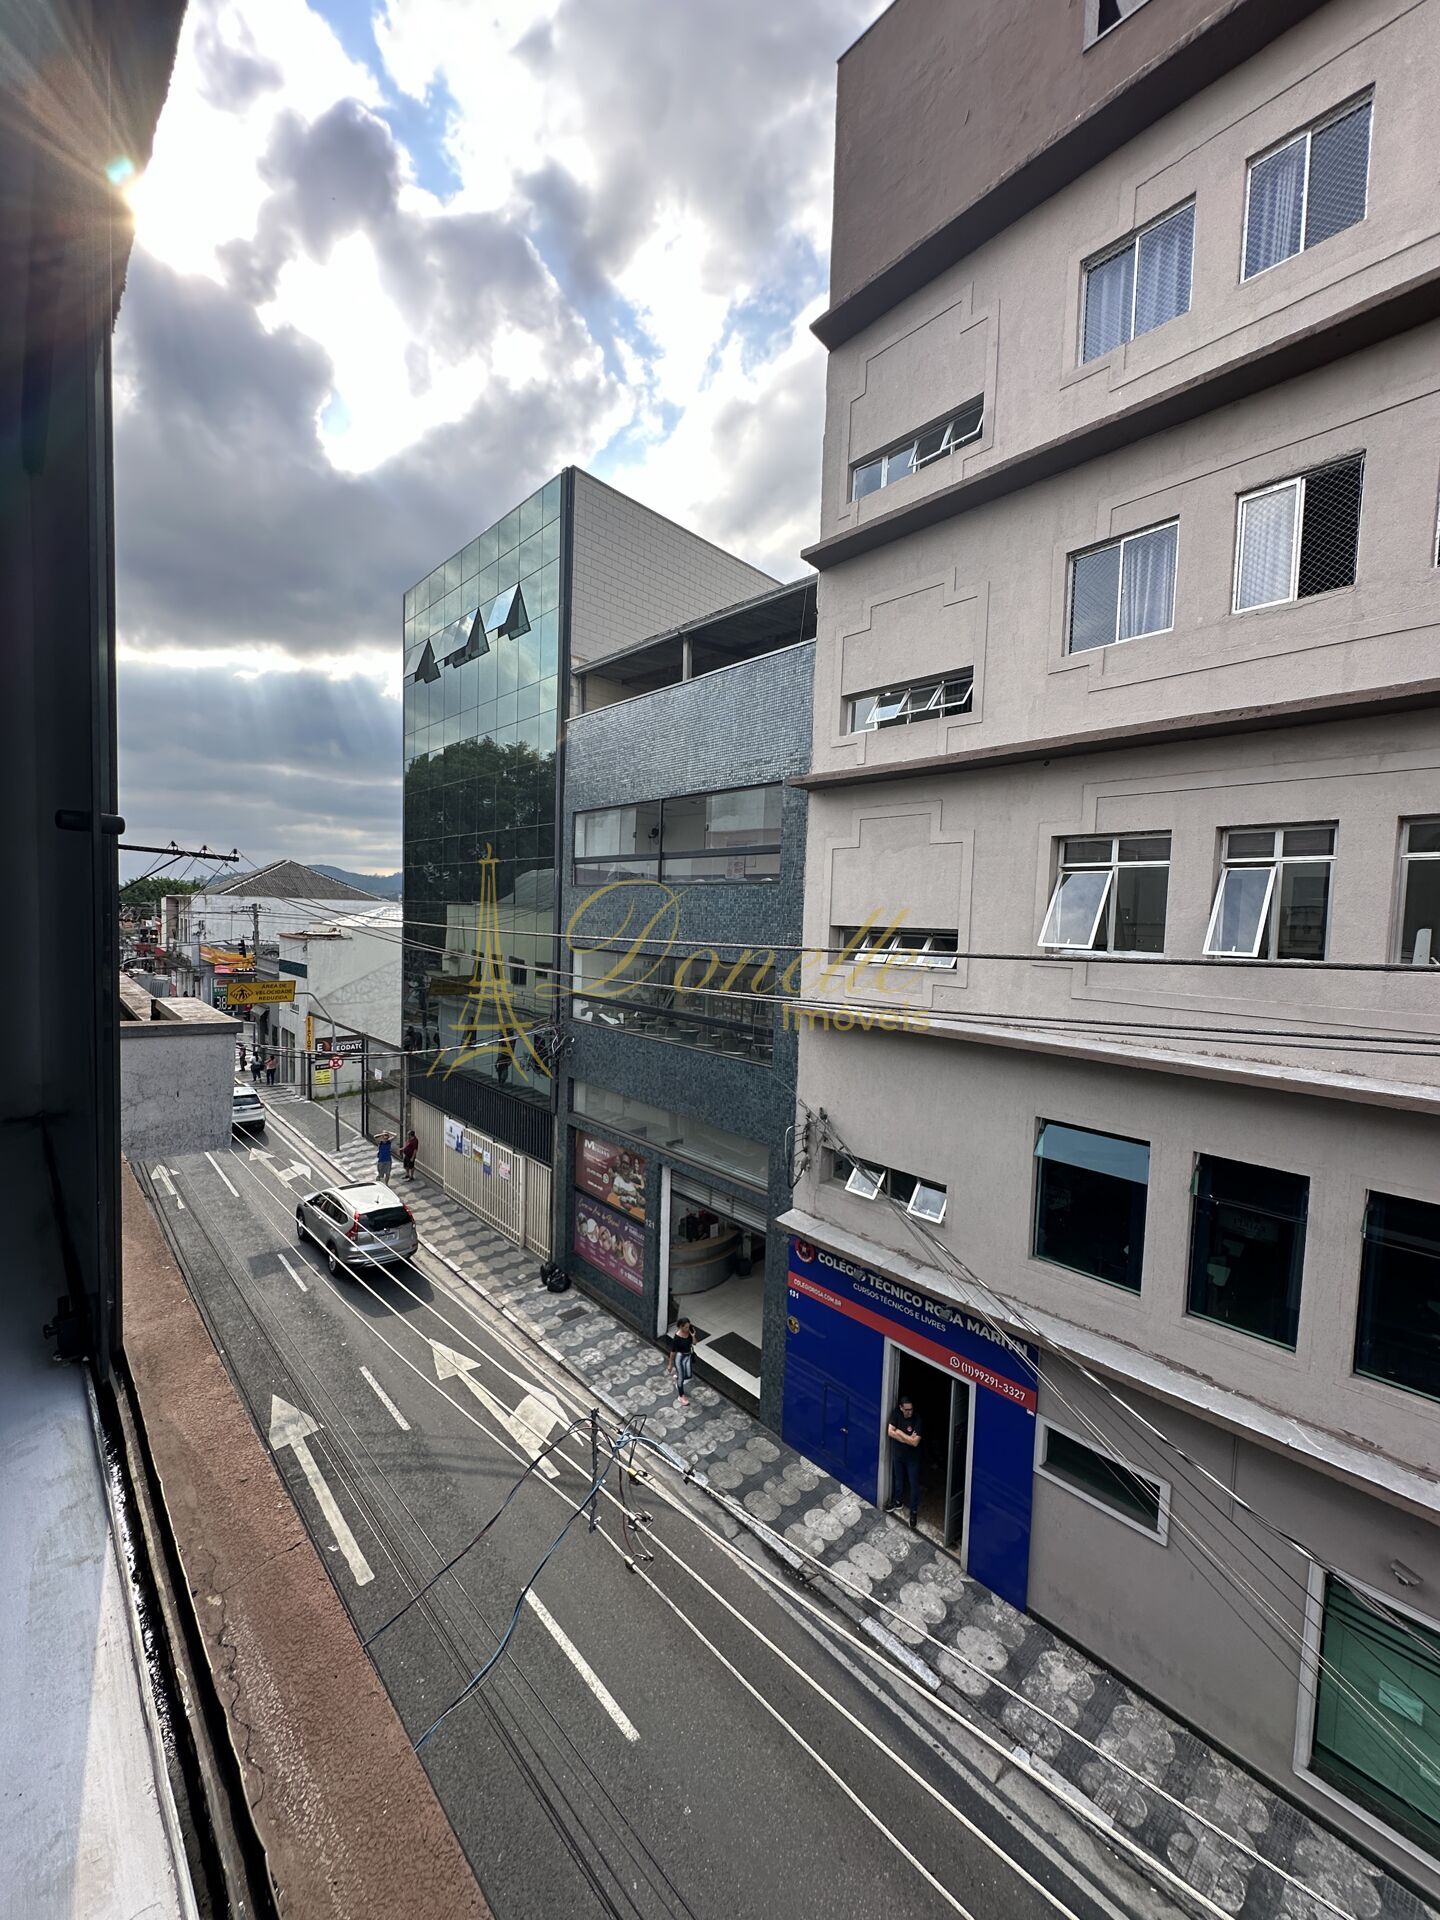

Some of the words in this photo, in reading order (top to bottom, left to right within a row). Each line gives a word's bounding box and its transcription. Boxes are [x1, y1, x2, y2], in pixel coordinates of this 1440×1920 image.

[817, 1252, 866, 1282] COLÉG
[868, 1274, 922, 1308] TÉCNICO
[853, 1282, 879, 1300] CURSOS
[880, 1295, 914, 1317] TÉCNICOS
[914, 1311, 921, 1320] E
[921, 1314, 947, 1332] LIVRES
